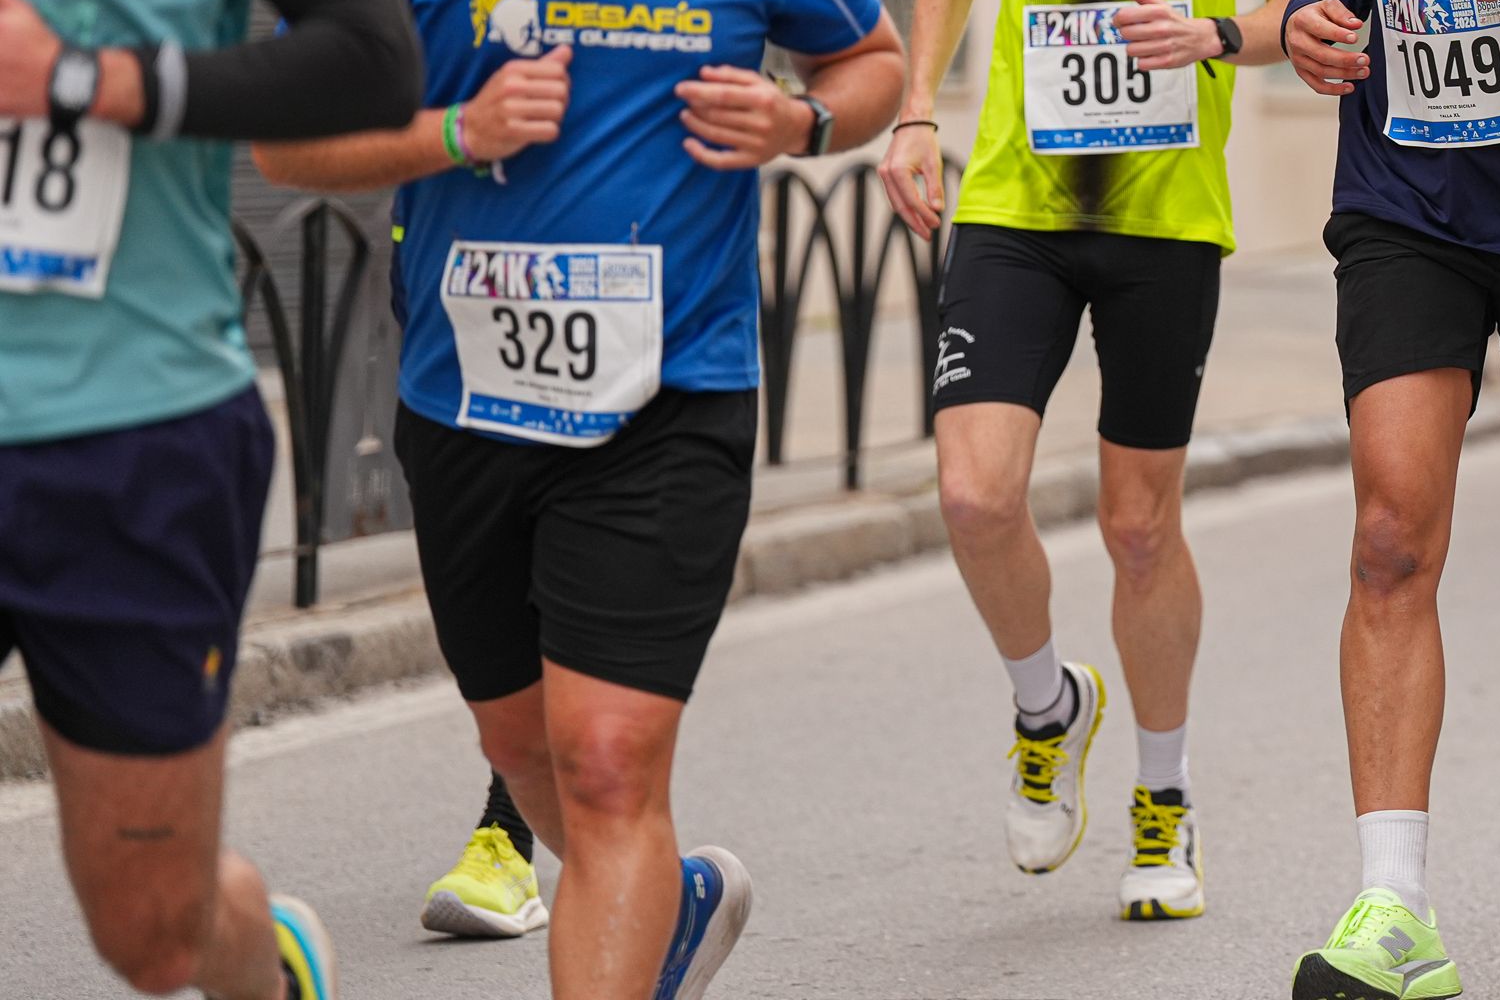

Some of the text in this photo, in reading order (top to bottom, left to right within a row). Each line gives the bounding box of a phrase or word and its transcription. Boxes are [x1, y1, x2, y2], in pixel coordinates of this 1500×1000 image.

[545, 1, 712, 34] DESAFÍO
[1047, 11, 1098, 45] 21K
[1454, 16, 1476, 30] 2026
[1062, 53, 1151, 105] 305
[469, 250, 531, 299] 21K
[493, 306, 596, 380] 329
